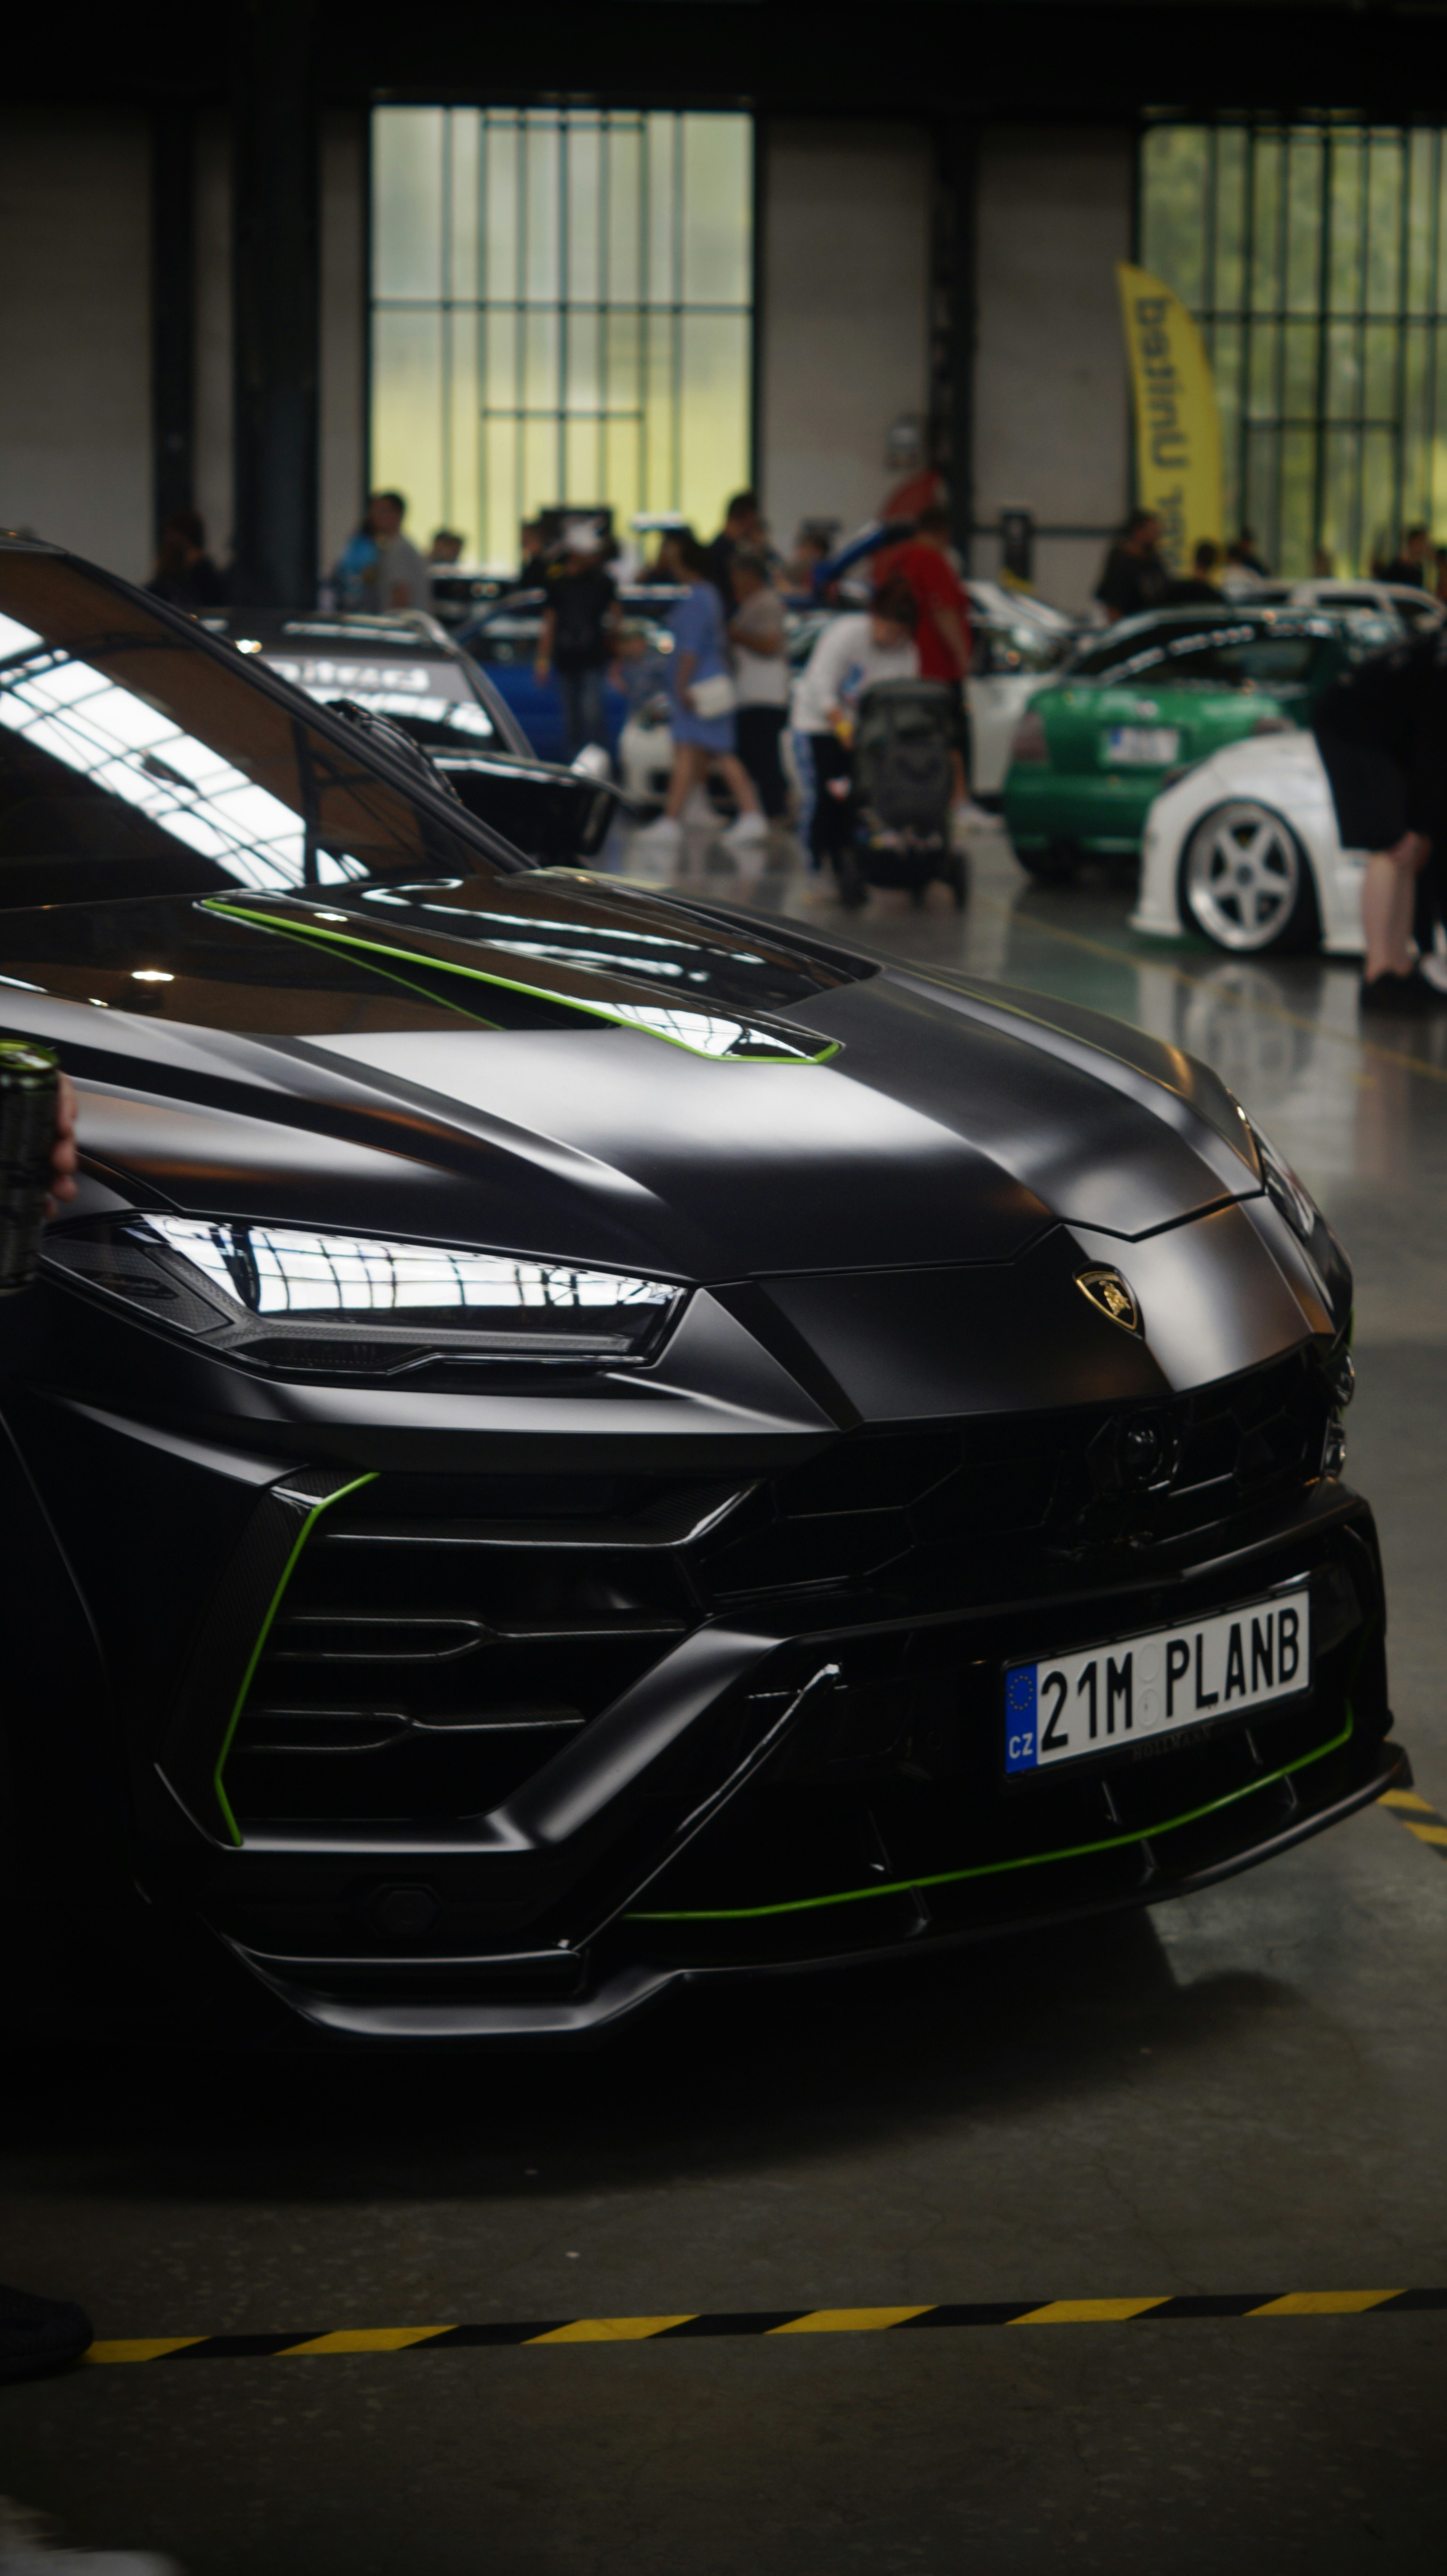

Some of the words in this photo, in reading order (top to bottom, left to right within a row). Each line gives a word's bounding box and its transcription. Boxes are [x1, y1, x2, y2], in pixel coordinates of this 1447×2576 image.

[1041, 1652, 1133, 1751] 21M
[1167, 1608, 1299, 1718] PLANB
[1008, 1732, 1034, 1760] CZ
